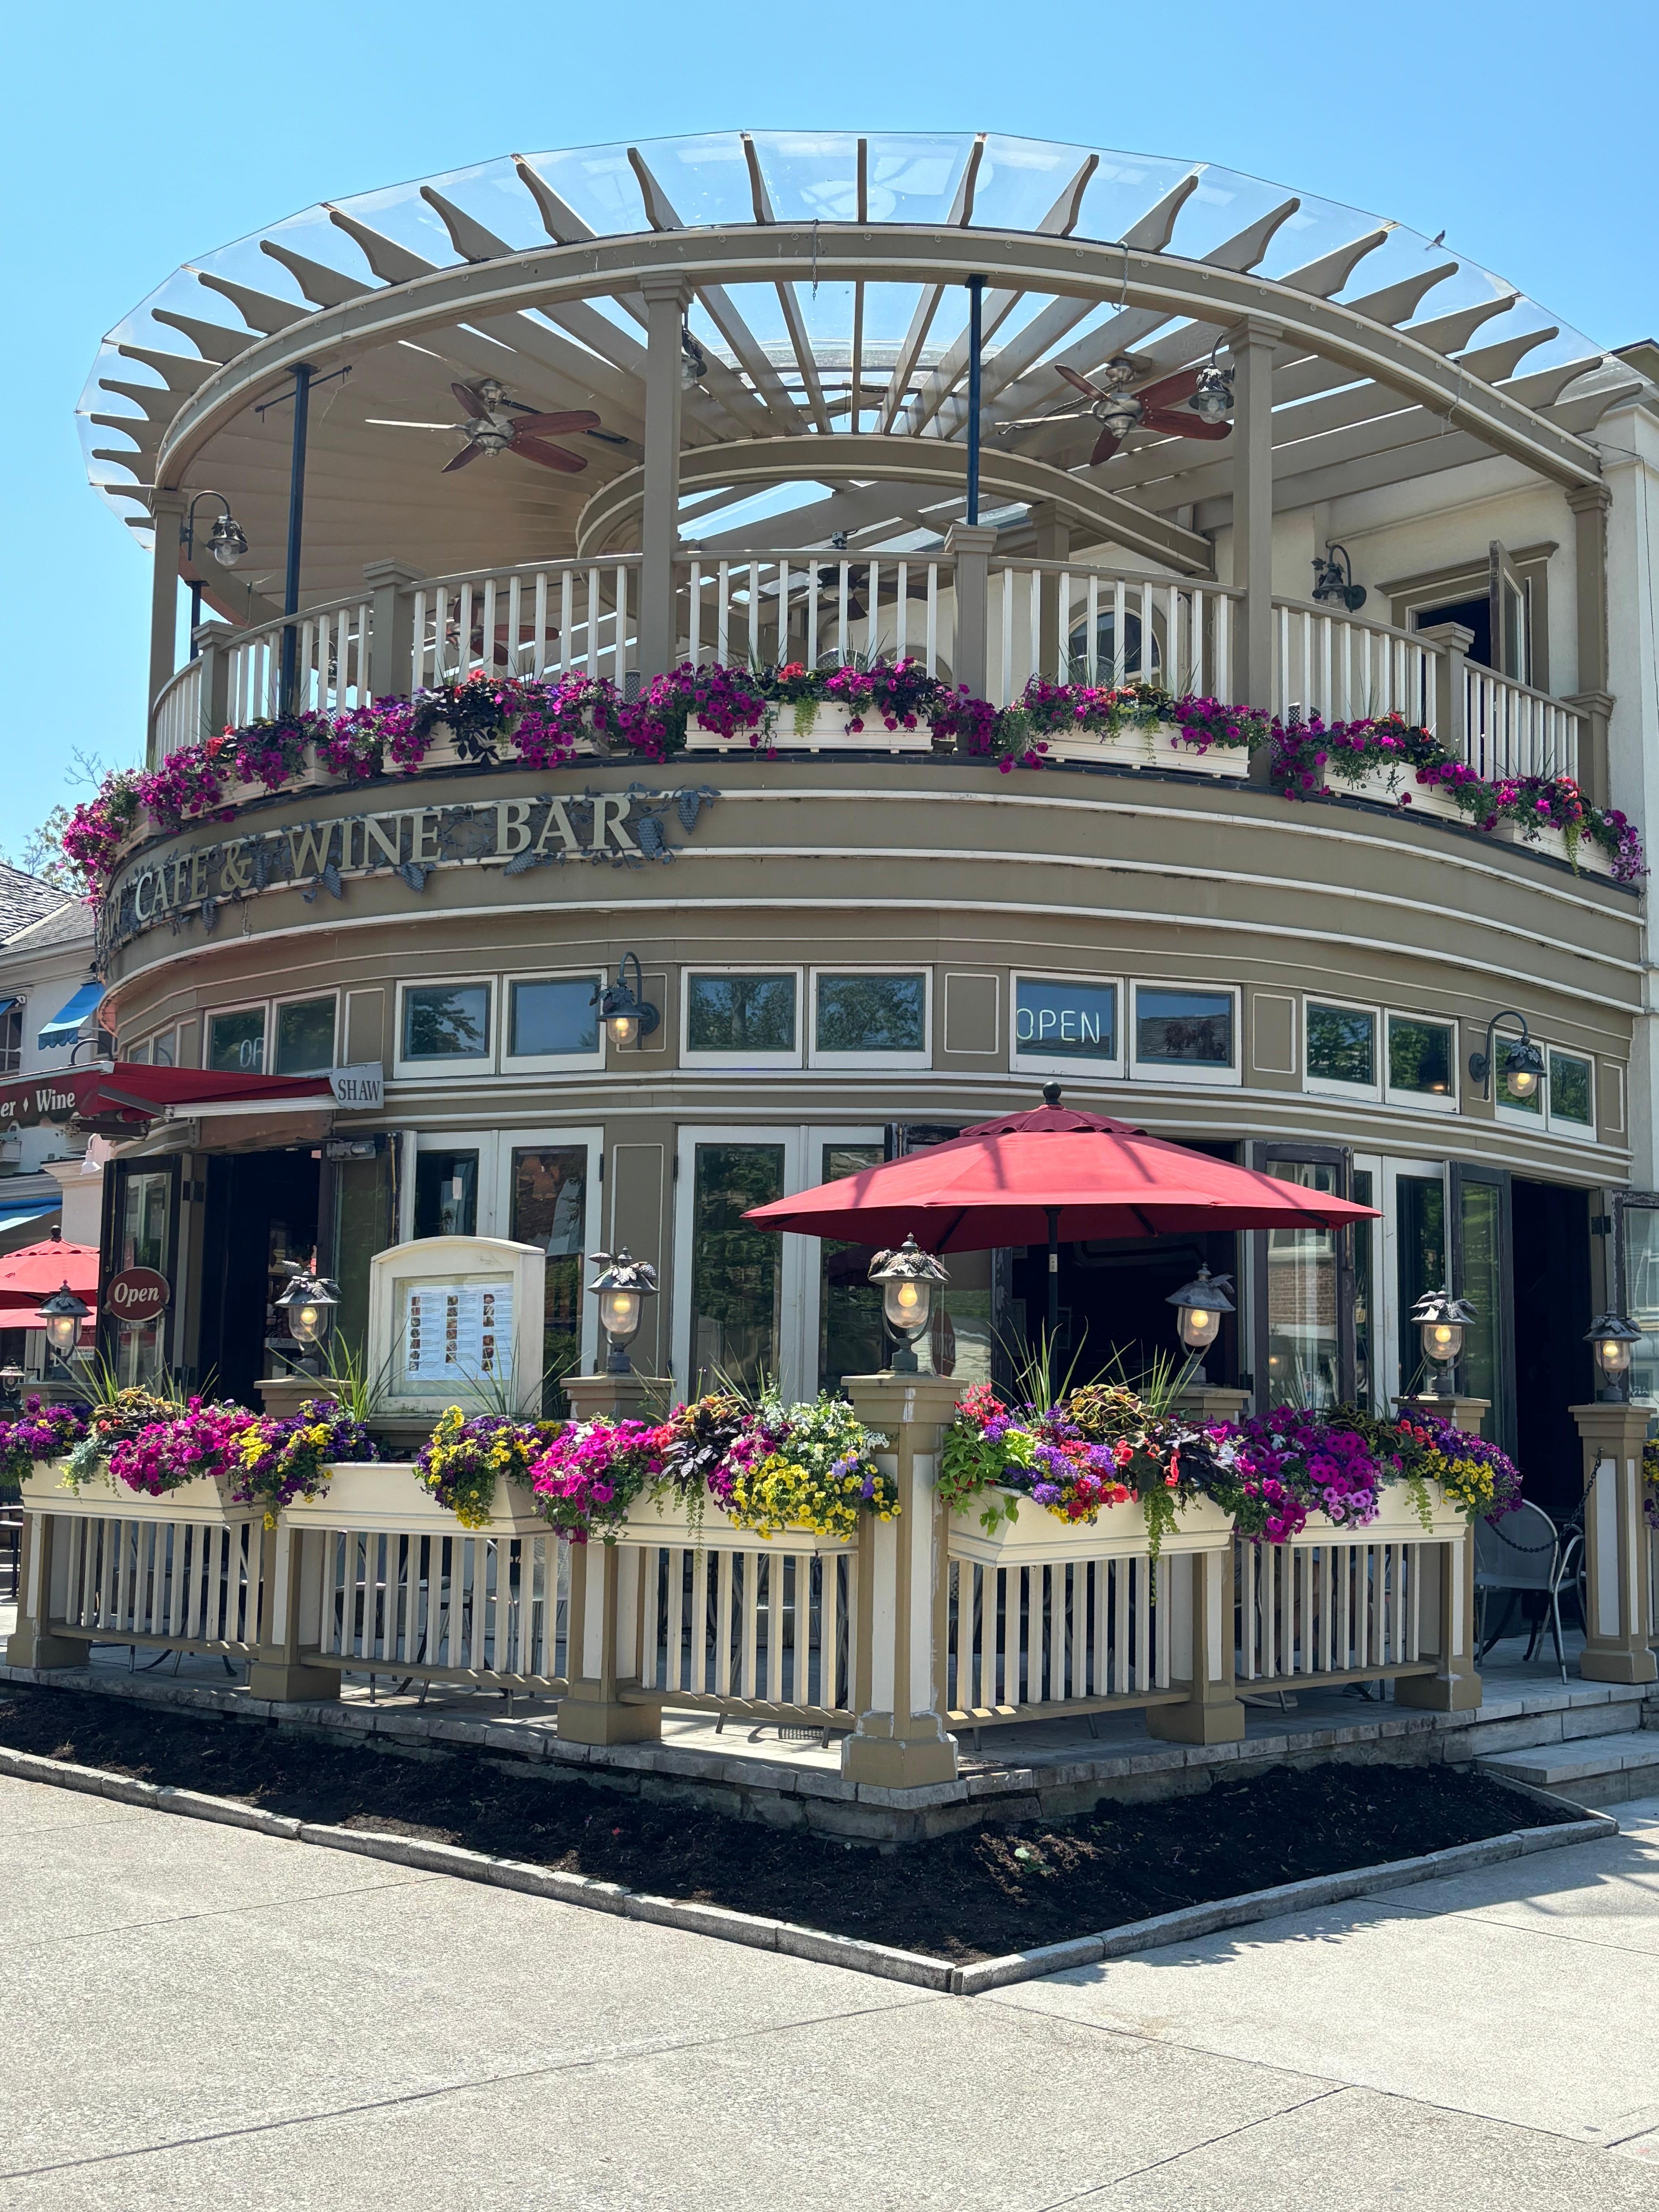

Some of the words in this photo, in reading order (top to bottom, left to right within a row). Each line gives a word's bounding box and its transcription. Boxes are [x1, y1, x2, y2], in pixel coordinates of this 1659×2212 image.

[136, 850, 210, 921] CAFE
[220, 841, 252, 892] &
[285, 810, 442, 878] WINE
[493, 796, 637, 854] BAR
[1016, 1008, 1099, 1044] OPEN
[35, 1089, 75, 1112] Wine
[338, 1079, 380, 1101] SHAW
[114, 1283, 160, 1307] Open
